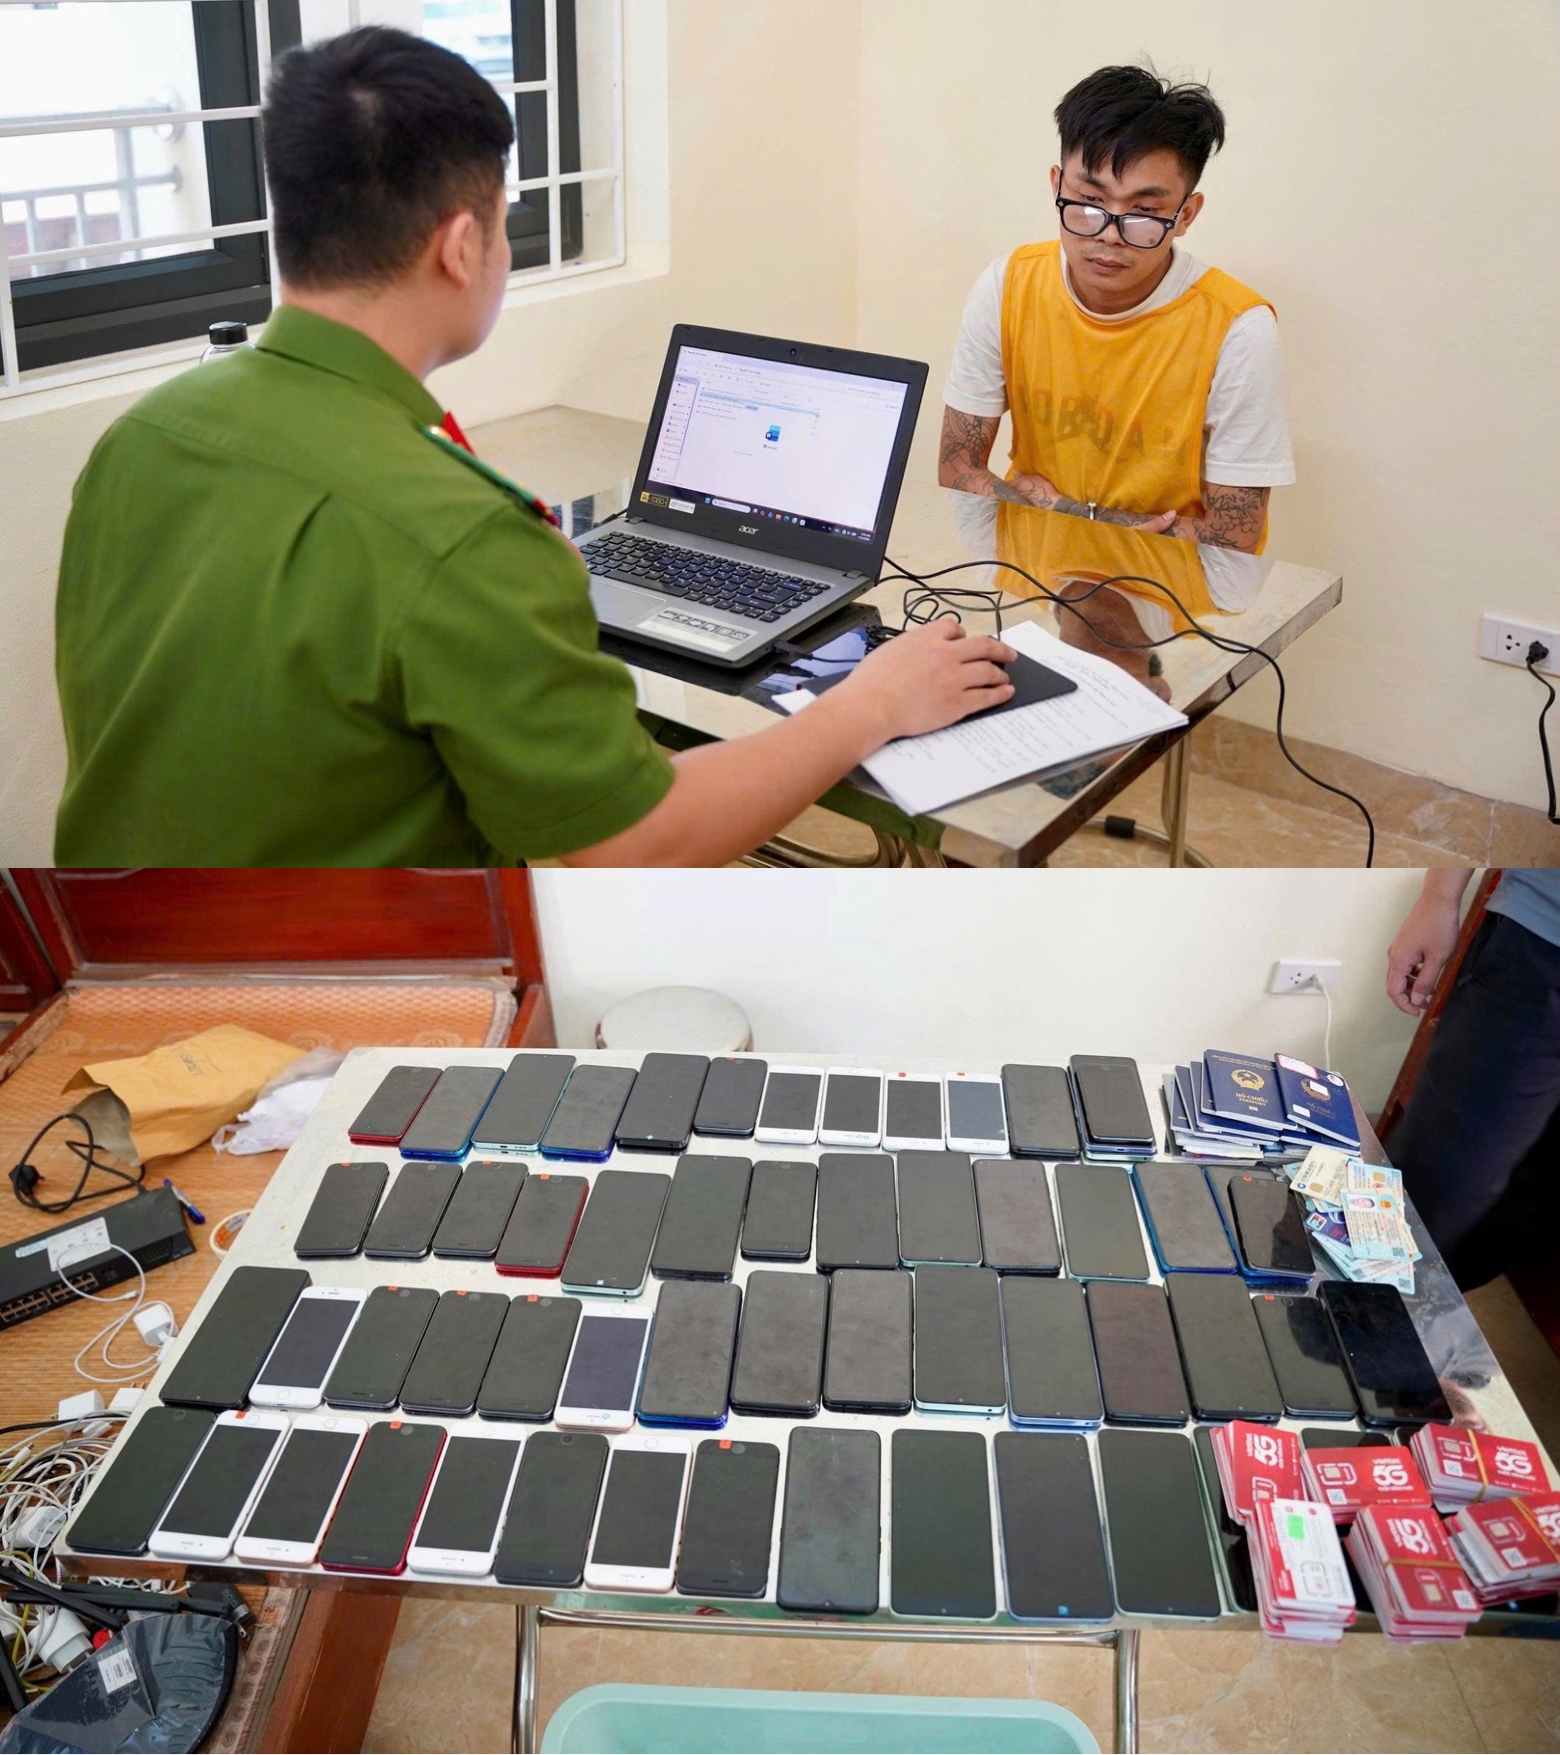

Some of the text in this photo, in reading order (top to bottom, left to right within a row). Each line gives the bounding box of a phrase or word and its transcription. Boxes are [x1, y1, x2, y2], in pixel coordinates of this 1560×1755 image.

[739, 525, 759, 535] acer
[1252, 1434, 1278, 1466] 5G
[1373, 1464, 1409, 1486] 5G
[1494, 1451, 1533, 1475] 5G
[1399, 1518, 1430, 1554] 5G
